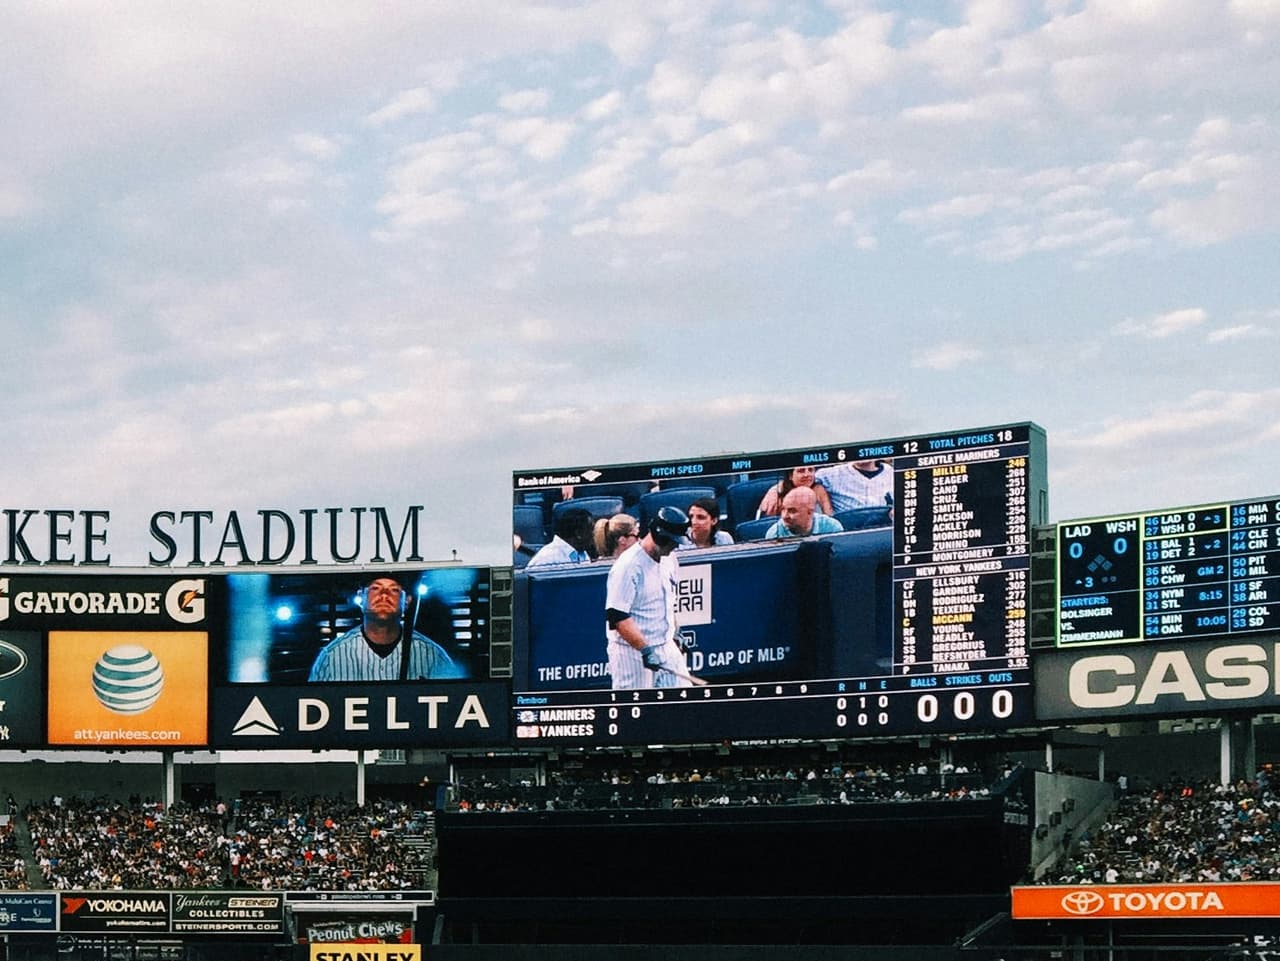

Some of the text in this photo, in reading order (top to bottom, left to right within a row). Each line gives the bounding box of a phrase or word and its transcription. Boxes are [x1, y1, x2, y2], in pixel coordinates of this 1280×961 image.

[519, 478, 536, 486] Bank
[548, 475, 580, 485] America
[652, 467, 675, 477] PITCH
[677, 465, 703, 475] SPEED
[733, 460, 751, 470] MPH
[803, 453, 828, 463] BALLS
[838, 450, 846, 461] 6
[859, 446, 894, 457] STRIKES
[903, 442, 919, 453] 12
[929, 439, 955, 449] TOTAL
[958, 434, 994, 446] PITCHES
[997, 431, 1012, 442] 18
[918, 450, 1000, 466] SEATTLE MARINERS
[933, 465, 966, 476] MILLER
[933, 475, 968, 486] SEAGER
[933, 485, 958, 495] CANO
[933, 494, 957, 504] CRUZ
[933, 503, 963, 514] SMITH
[1248, 504, 1268, 514] MIA
[933, 511, 973, 523] JACKSON
[1161, 514, 1181, 524] LAD
[1248, 514, 1266, 524] PHI
[933, 521, 968, 532] ACKLEY
[1065, 520, 1137, 538] LAD WSH
[1161, 524, 1184, 534] WSH
[148, 505, 424, 567] STADIUM
[933, 529, 981, 541] MORRISON
[1248, 529, 1268, 539] CLE
[933, 540, 968, 551] ZUNINO
[1069, 537, 1127, 558] 0 0
[1161, 539, 1181, 548] BAL
[1248, 540, 1267, 549] CIN
[933, 549, 993, 561] MONTGOMERY
[1161, 549, 1181, 559] DET
[916, 561, 1002, 576] NEW YORK YANKEES
[1249, 566, 1268, 576] MIL
[933, 576, 979, 587] ELLSBURY
[1161, 574, 1185, 584] CHW
[933, 585, 975, 596] GARDNER
[1161, 589, 1184, 599] NYM
[15, 592, 161, 615] GATORADE
[165, 579, 206, 623] G
[933, 594, 984, 606] RODRIGUEZ
[1062, 596, 1109, 607] STARTERS:
[1161, 600, 1180, 609] STL
[933, 604, 975, 615] TEIXEIRA
[1061, 607, 1113, 619] BOLSINGER
[1249, 607, 1270, 616] COL
[933, 613, 972, 624] MCCANN
[1161, 615, 1182, 624] MIN
[933, 624, 964, 634] YOUNG
[1161, 625, 1183, 634] OAK
[933, 632, 974, 643] HEADLEY
[1061, 630, 1124, 642] ZIMMERMANN
[933, 640, 985, 652] GREGORIUS
[709, 652, 735, 667] CAP
[738, 650, 754, 664] OF
[758, 647, 784, 661] MLB
[538, 663, 610, 681] THE OFFICIA
[933, 662, 969, 673] TANAKA
[910, 673, 1012, 687] BALLS STRIKES OUTS
[1069, 643, 1280, 709] CAS
[917, 690, 1013, 723] 0 0 0
[298, 694, 490, 732] DELTA
[540, 709, 595, 721] MARINERS
[74, 728, 181, 744] att.yankees.com
[541, 724, 594, 737] YANKEES
[87, 900, 166, 912] YOKOHAMA
[1108, 892, 1224, 911] TOYOTA
[189, 910, 264, 918] COLLECTIBLES
[176, 923, 279, 931] STEINERSPORTS.COM
[308, 926, 354, 942] Peanut
